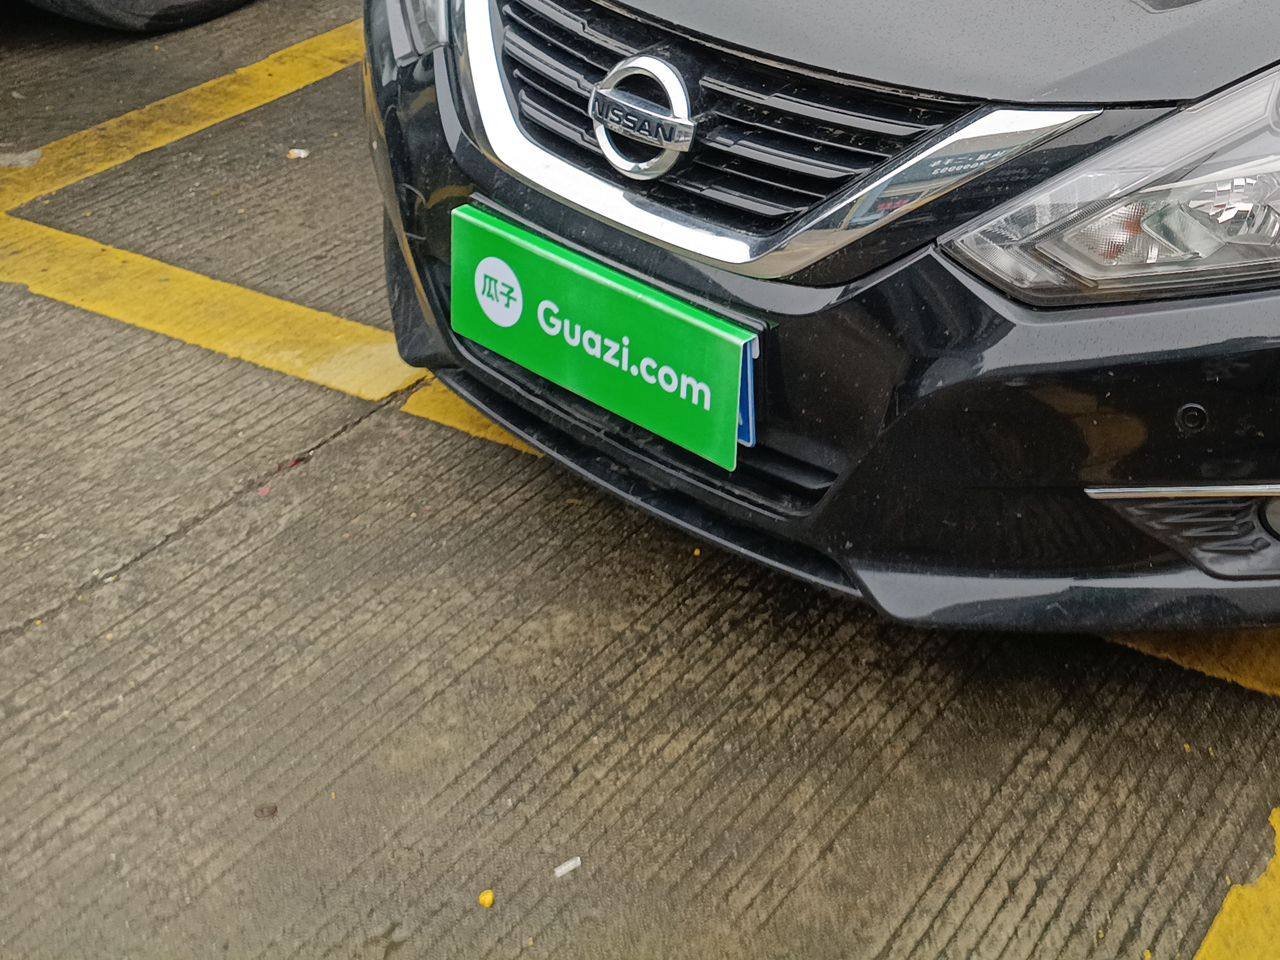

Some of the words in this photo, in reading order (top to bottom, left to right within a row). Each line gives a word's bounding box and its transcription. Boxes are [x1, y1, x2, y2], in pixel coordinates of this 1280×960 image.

[593, 98, 674, 142] NISSAN
[481, 273, 517, 309] 瓜子
[537, 300, 711, 411] Guazi.com
